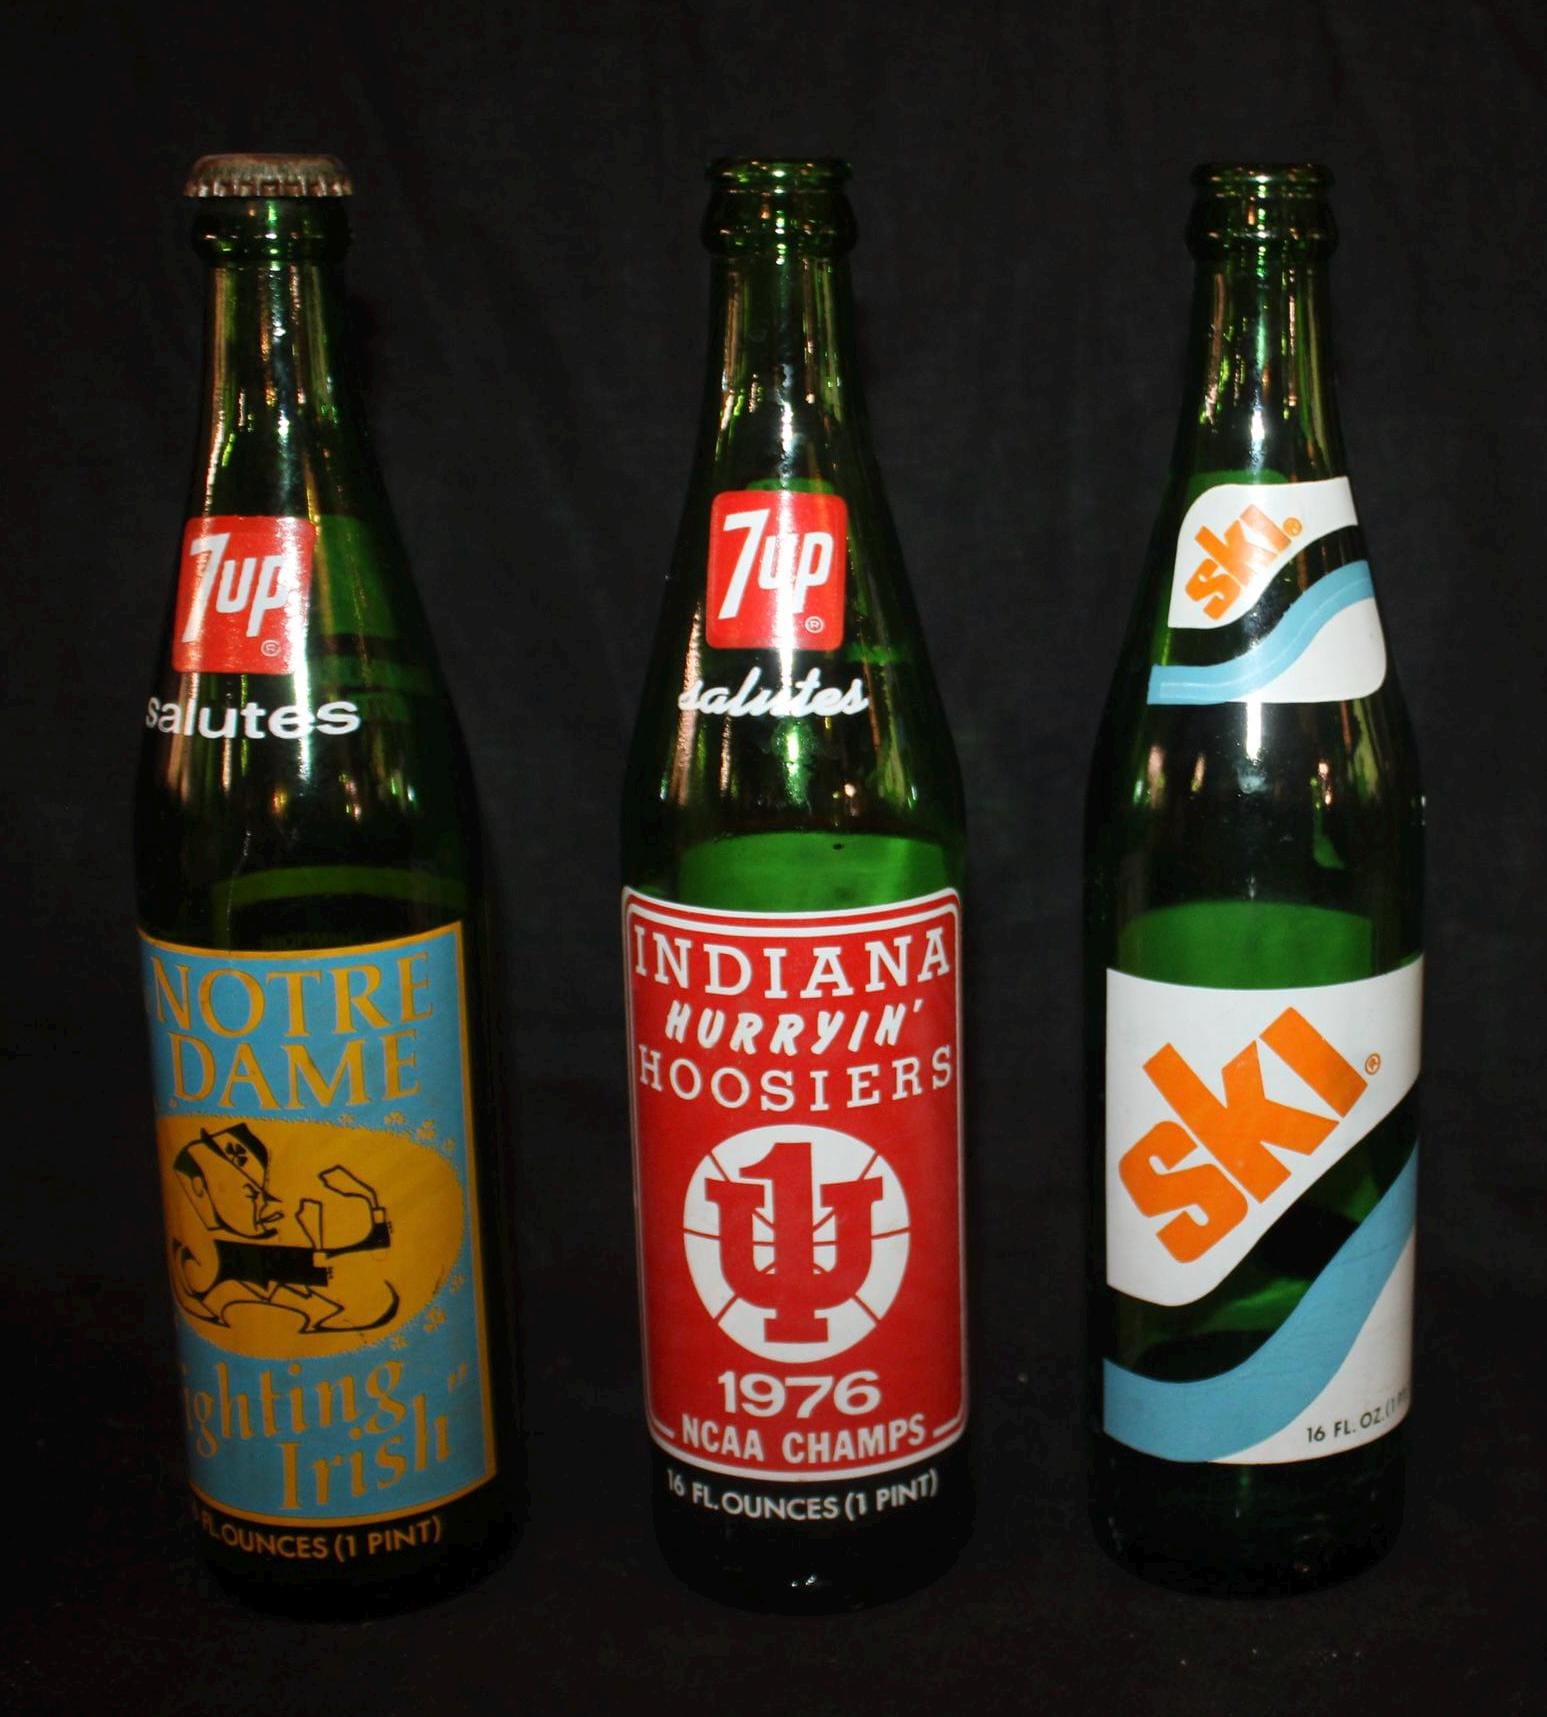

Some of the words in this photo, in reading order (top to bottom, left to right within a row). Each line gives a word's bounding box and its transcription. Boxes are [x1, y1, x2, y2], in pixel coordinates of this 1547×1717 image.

[145, 696, 362, 740] salutes
[677, 666, 870, 718] salutes
[633, 925, 951, 1001] INDIANA
[150, 951, 433, 1038] NOTRE
[167, 1028, 422, 1111] DAME
[638, 1042, 952, 1113] HOOSIERS
[182, 1359, 408, 1459] ighting
[717, 1369, 882, 1419] 1976
[681, 1412, 766, 1463] NCAA
[781, 1412, 927, 1466] CHAMPS
[1306, 1425, 1327, 1444] 16
[1333, 1418, 1357, 1438] FL.
[666, 1468, 686, 1497] 16
[844, 1491, 869, 1522] (1
[875, 1467, 940, 1513] PINT)
[333, 1533, 358, 1563] (1
[366, 1514, 443, 1556] PINT)
